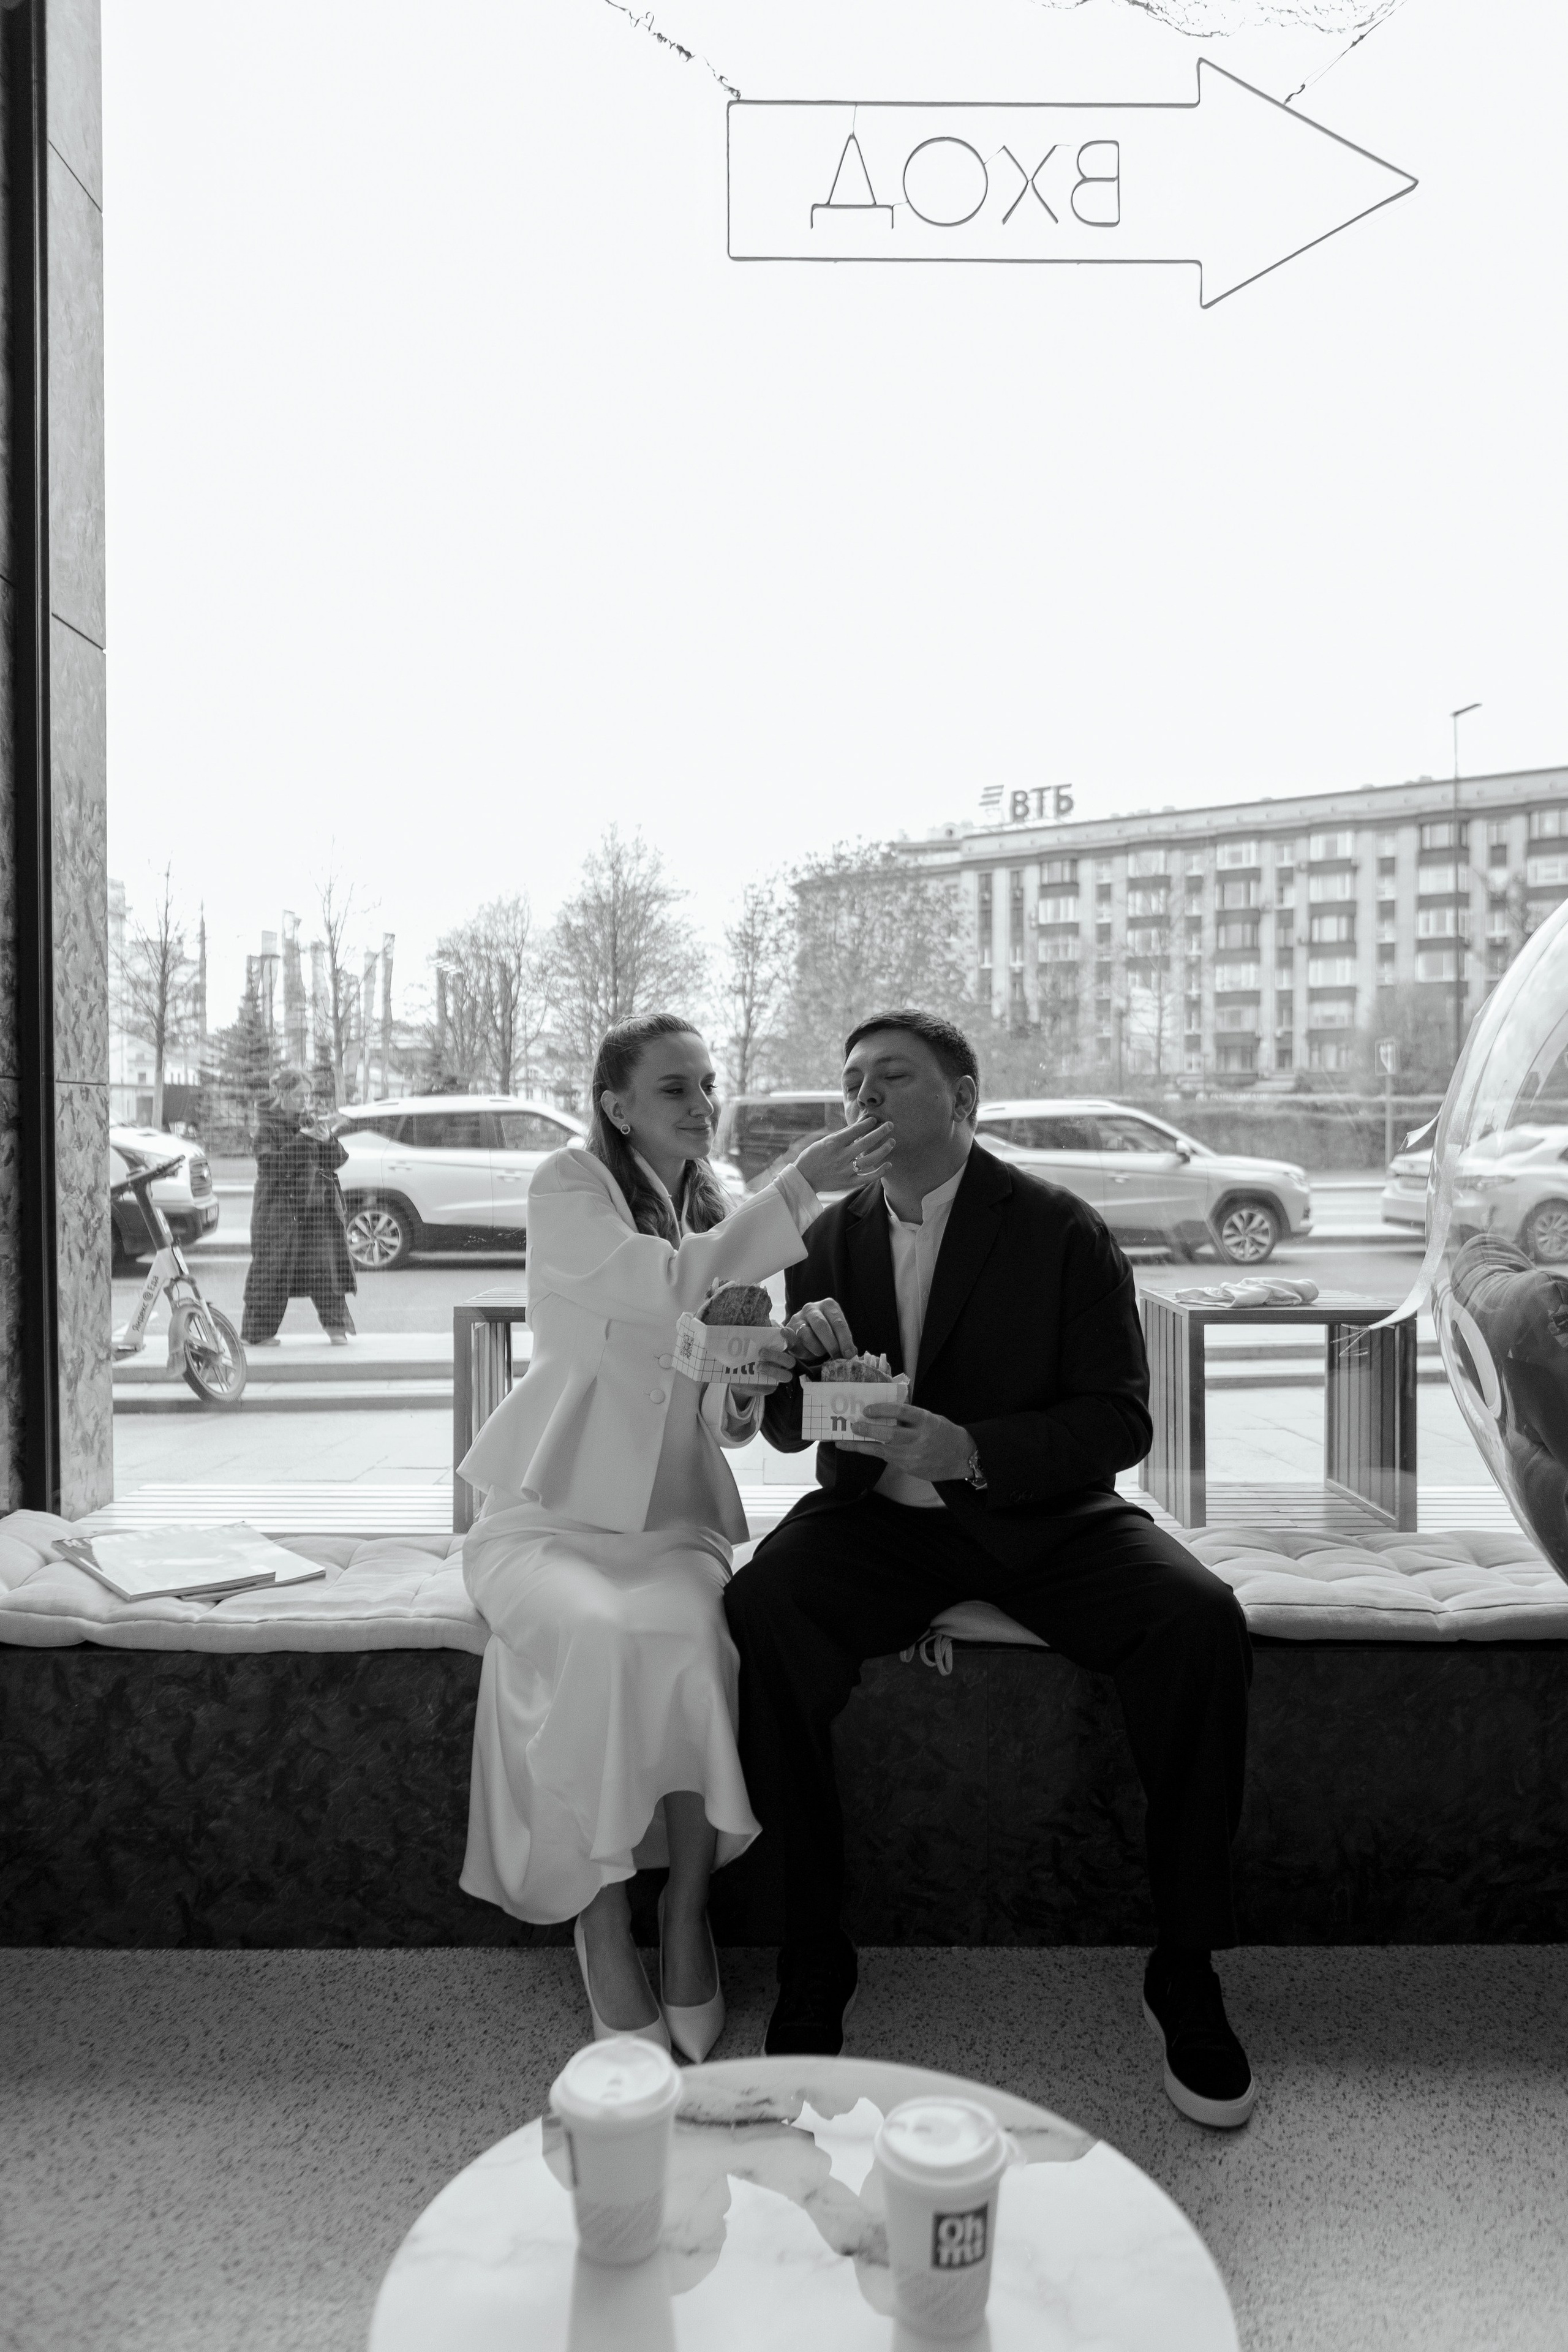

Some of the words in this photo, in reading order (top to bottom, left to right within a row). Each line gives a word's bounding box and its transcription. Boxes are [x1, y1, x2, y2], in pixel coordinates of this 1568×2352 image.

[1011, 783, 1074, 823] ВТБ
[147, 1276, 159, 1291] Еда
[938, 2215, 982, 2243] Oh
